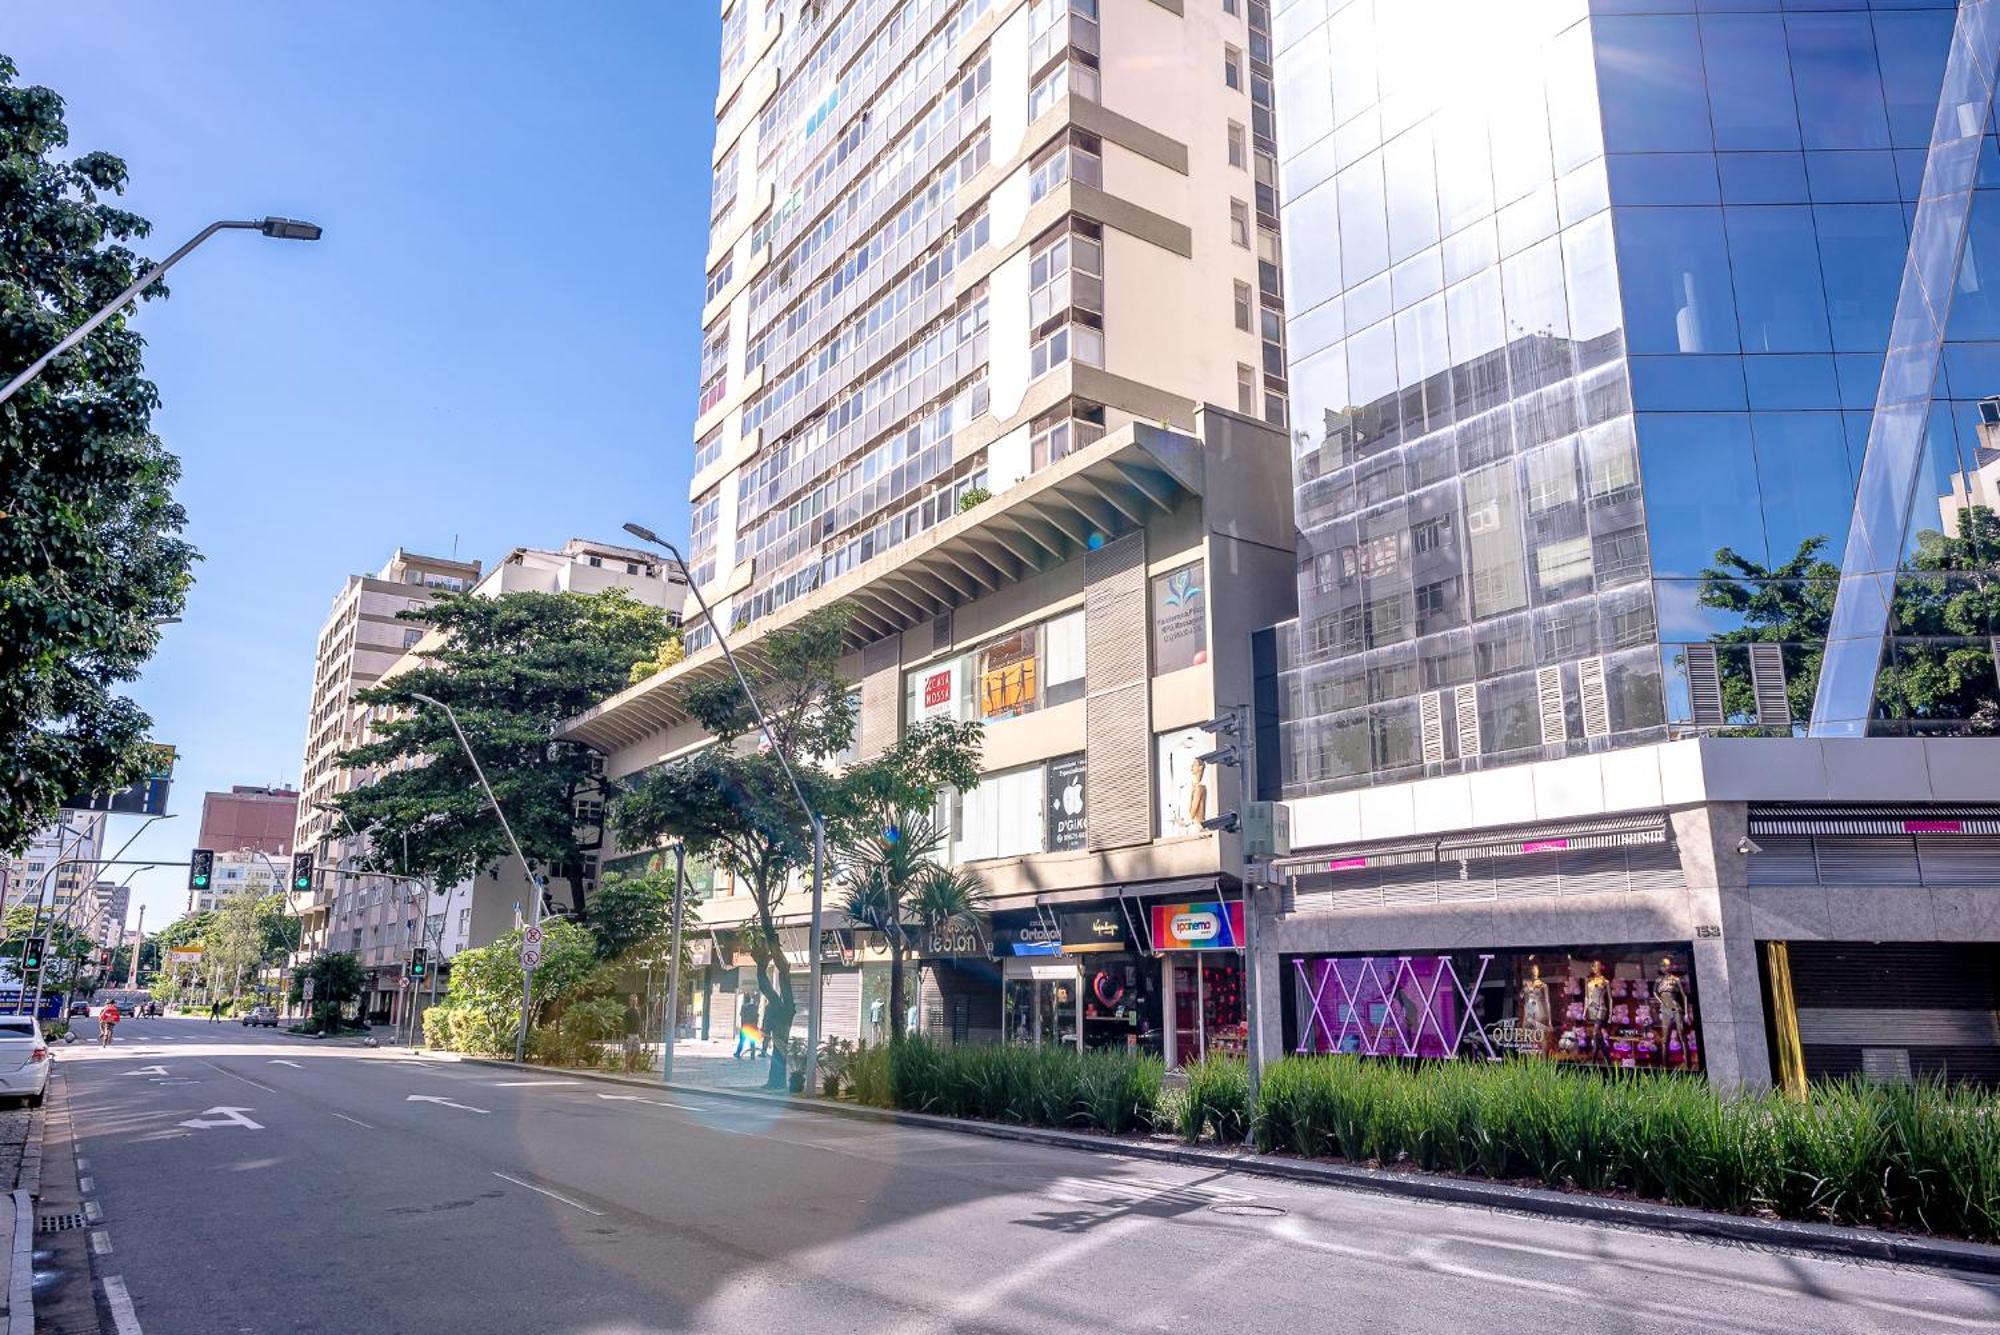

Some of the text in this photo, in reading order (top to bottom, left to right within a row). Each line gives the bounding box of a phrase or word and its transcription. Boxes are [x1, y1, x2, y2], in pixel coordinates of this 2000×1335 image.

[931, 673, 950, 690] CASA
[1176, 921, 1211, 934] ipanema
[1694, 925, 1721, 937] 153
[1492, 1027, 1545, 1046] QUERO
